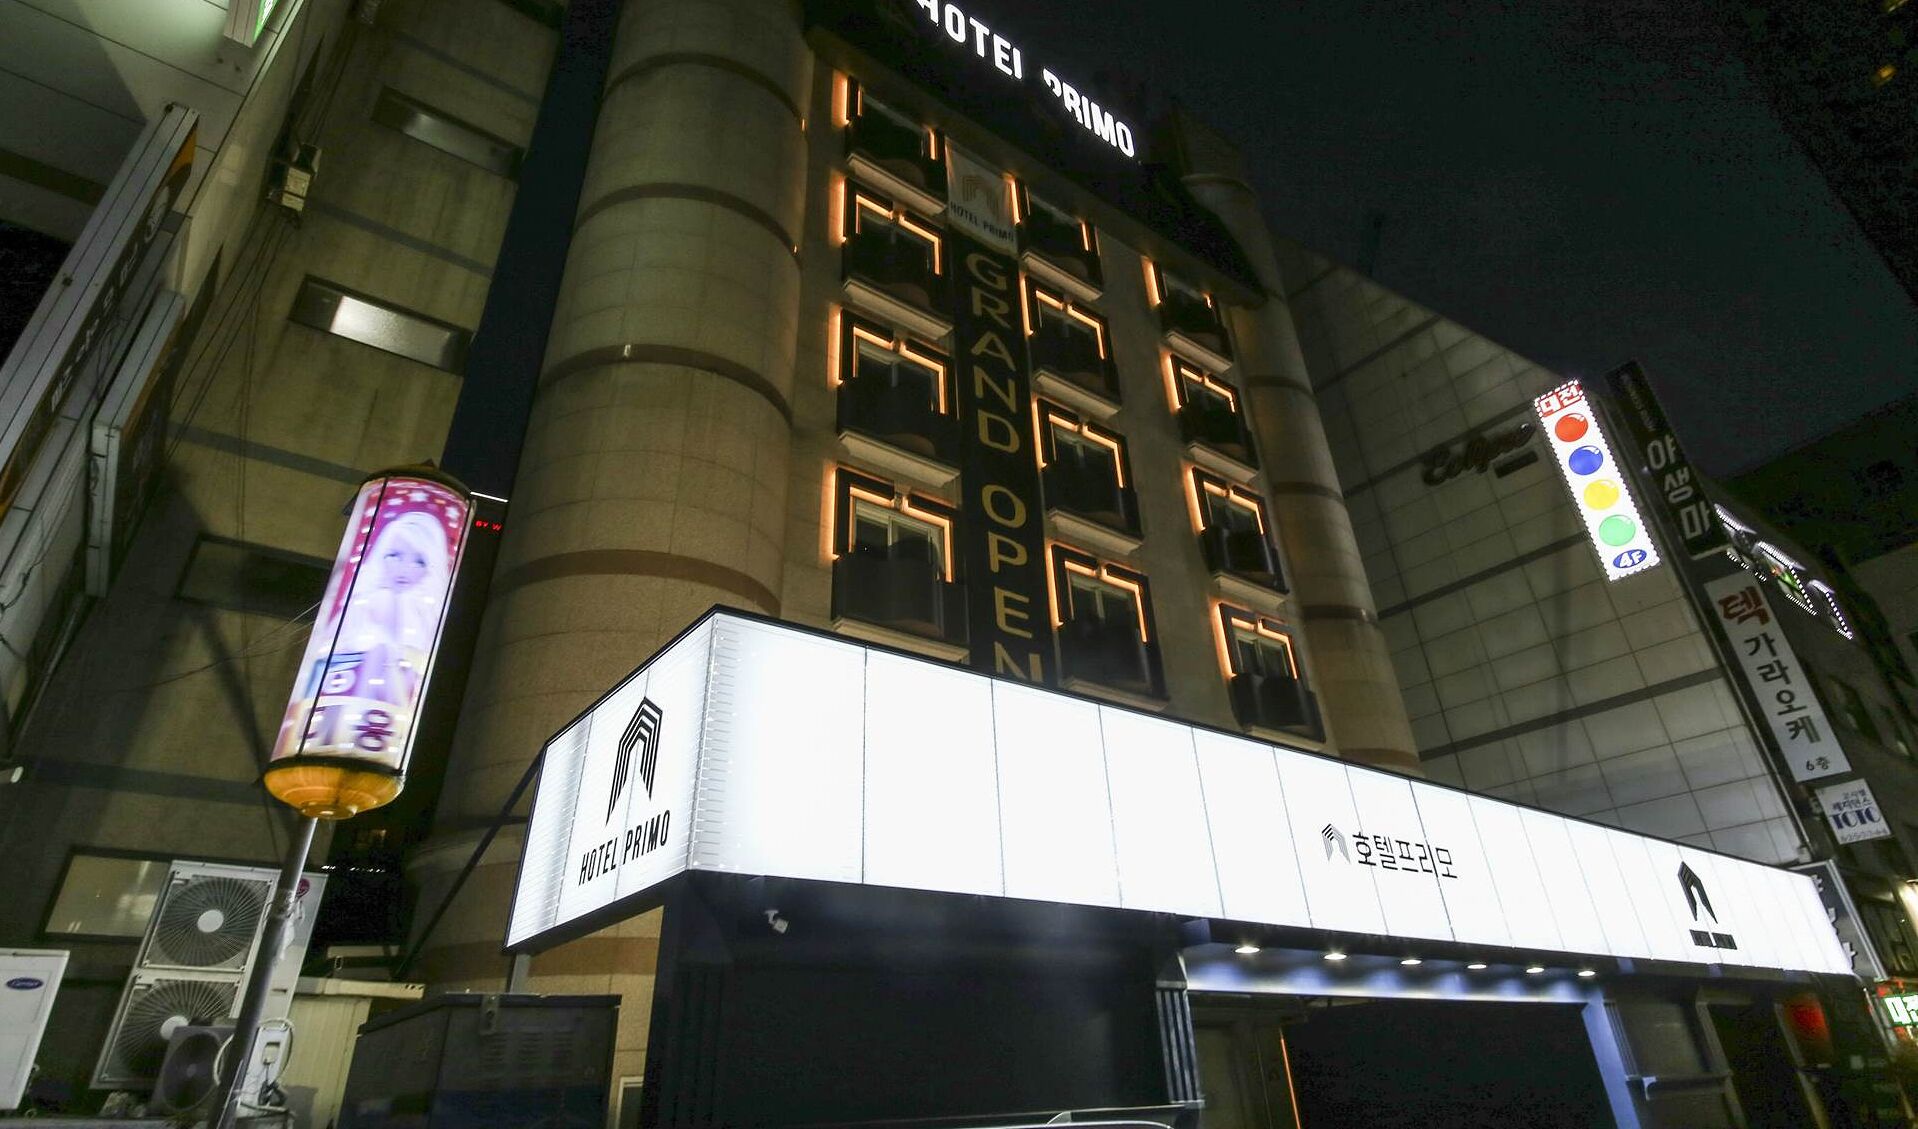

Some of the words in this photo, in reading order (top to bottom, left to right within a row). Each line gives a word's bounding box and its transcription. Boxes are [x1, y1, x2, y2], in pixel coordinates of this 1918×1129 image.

[966, 253, 1020, 453] GRAND
[1647, 434, 1711, 540] 야생마
[981, 484, 1044, 683] OPEN
[578, 837, 618, 887] HOTEL
[622, 809, 671, 866] PRIMO
[1352, 831, 1458, 879] 호텔프리모
